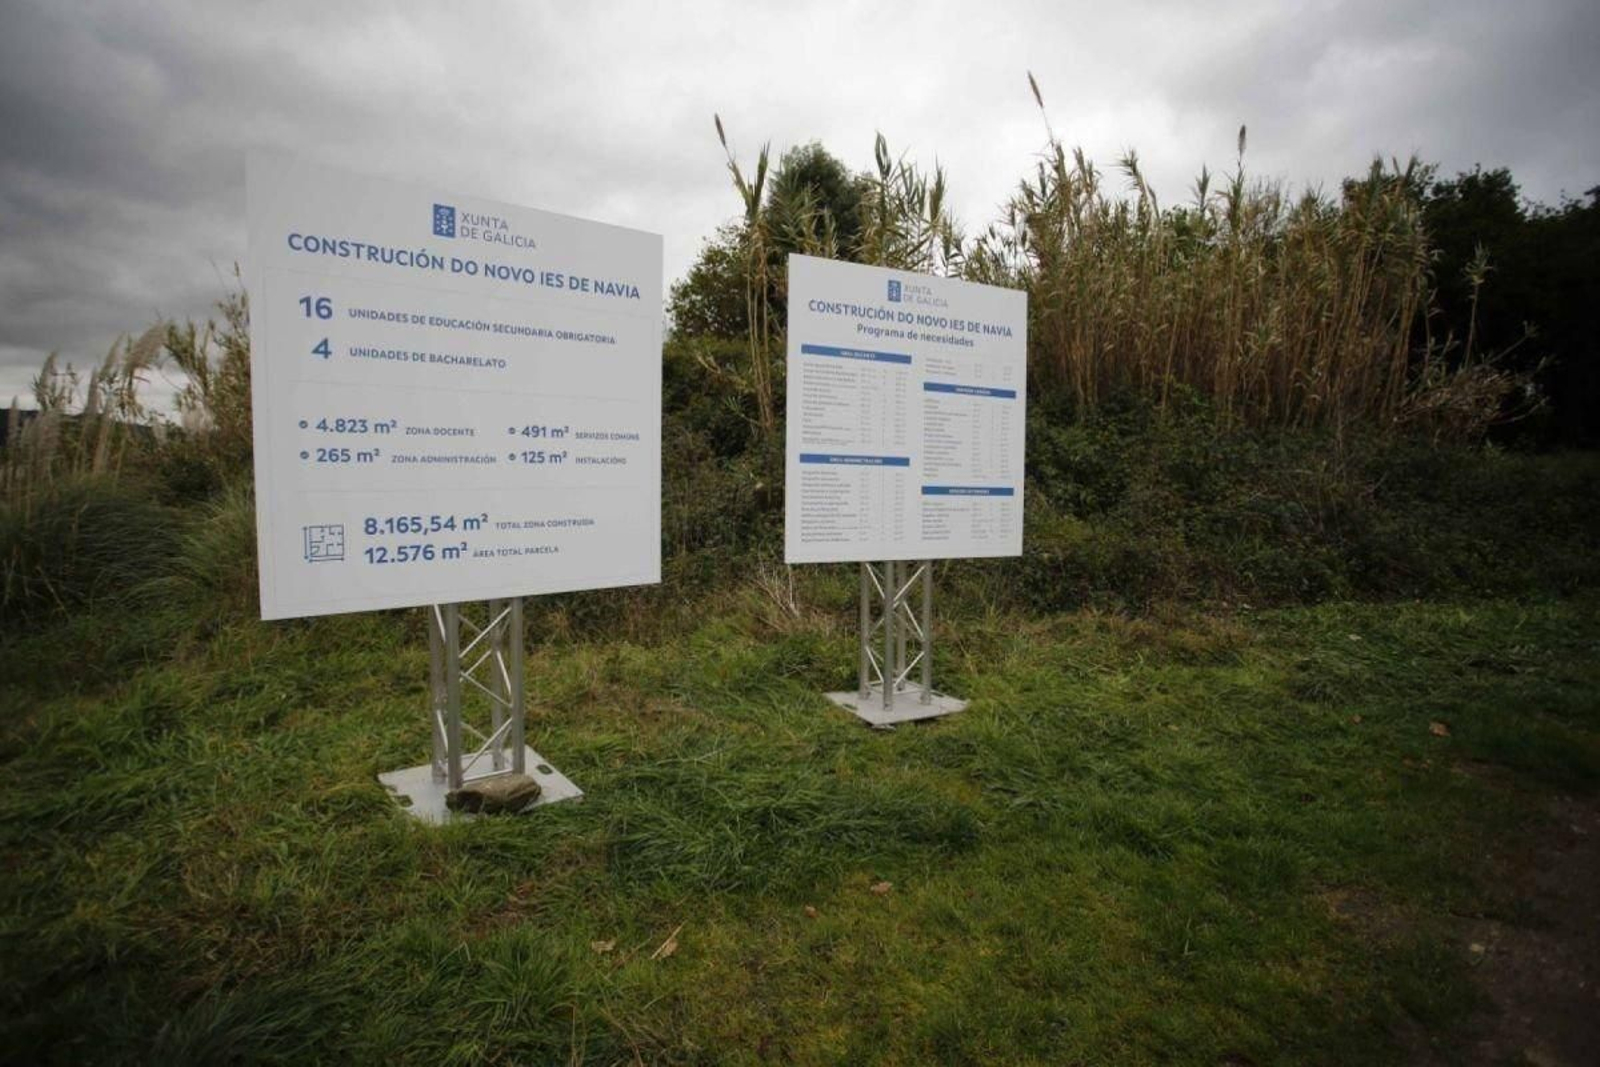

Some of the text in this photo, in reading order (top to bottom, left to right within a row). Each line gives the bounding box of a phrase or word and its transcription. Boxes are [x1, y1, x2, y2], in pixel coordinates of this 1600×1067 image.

[461, 212, 509, 231] XUNTA
[460, 226, 537, 249] DE GALICIA
[287, 233, 641, 300] CONSTRUCIÓN DO NOVO IES DE NAVIA
[903, 285, 932, 296] XUNTA
[903, 294, 949, 307] DE GALICIA
[299, 295, 616, 345] 16 UNIDADES DE EDUCACIÓN SECUNDARIA OBRIGATORIA
[808, 299, 1013, 338] CONSTRUCIÓN DO NOVO IES DE NAVIA
[857, 323, 974, 348] Programa de necesidades
[311, 337, 506, 369] 4 UNIDADES DE BACHARELATO
[315, 418, 368, 433] 4.823
[405, 427, 431, 436] ZONA
[433, 427, 475, 437] DOCENTE
[521, 425, 547, 438] 491
[316, 448, 351, 463] 265
[391, 455, 418, 464] ZONA
[420, 454, 497, 464] ADMINISTRACIÓN
[521, 451, 545, 464] 125
[364, 515, 457, 535] 8.165,54
[496, 522, 521, 530] TOTAL
[523, 521, 545, 529] ZONA
[364, 544, 435, 564] 12.576
[497, 548, 523, 557] TOTAL
[524, 546, 559, 555] PARCELA
